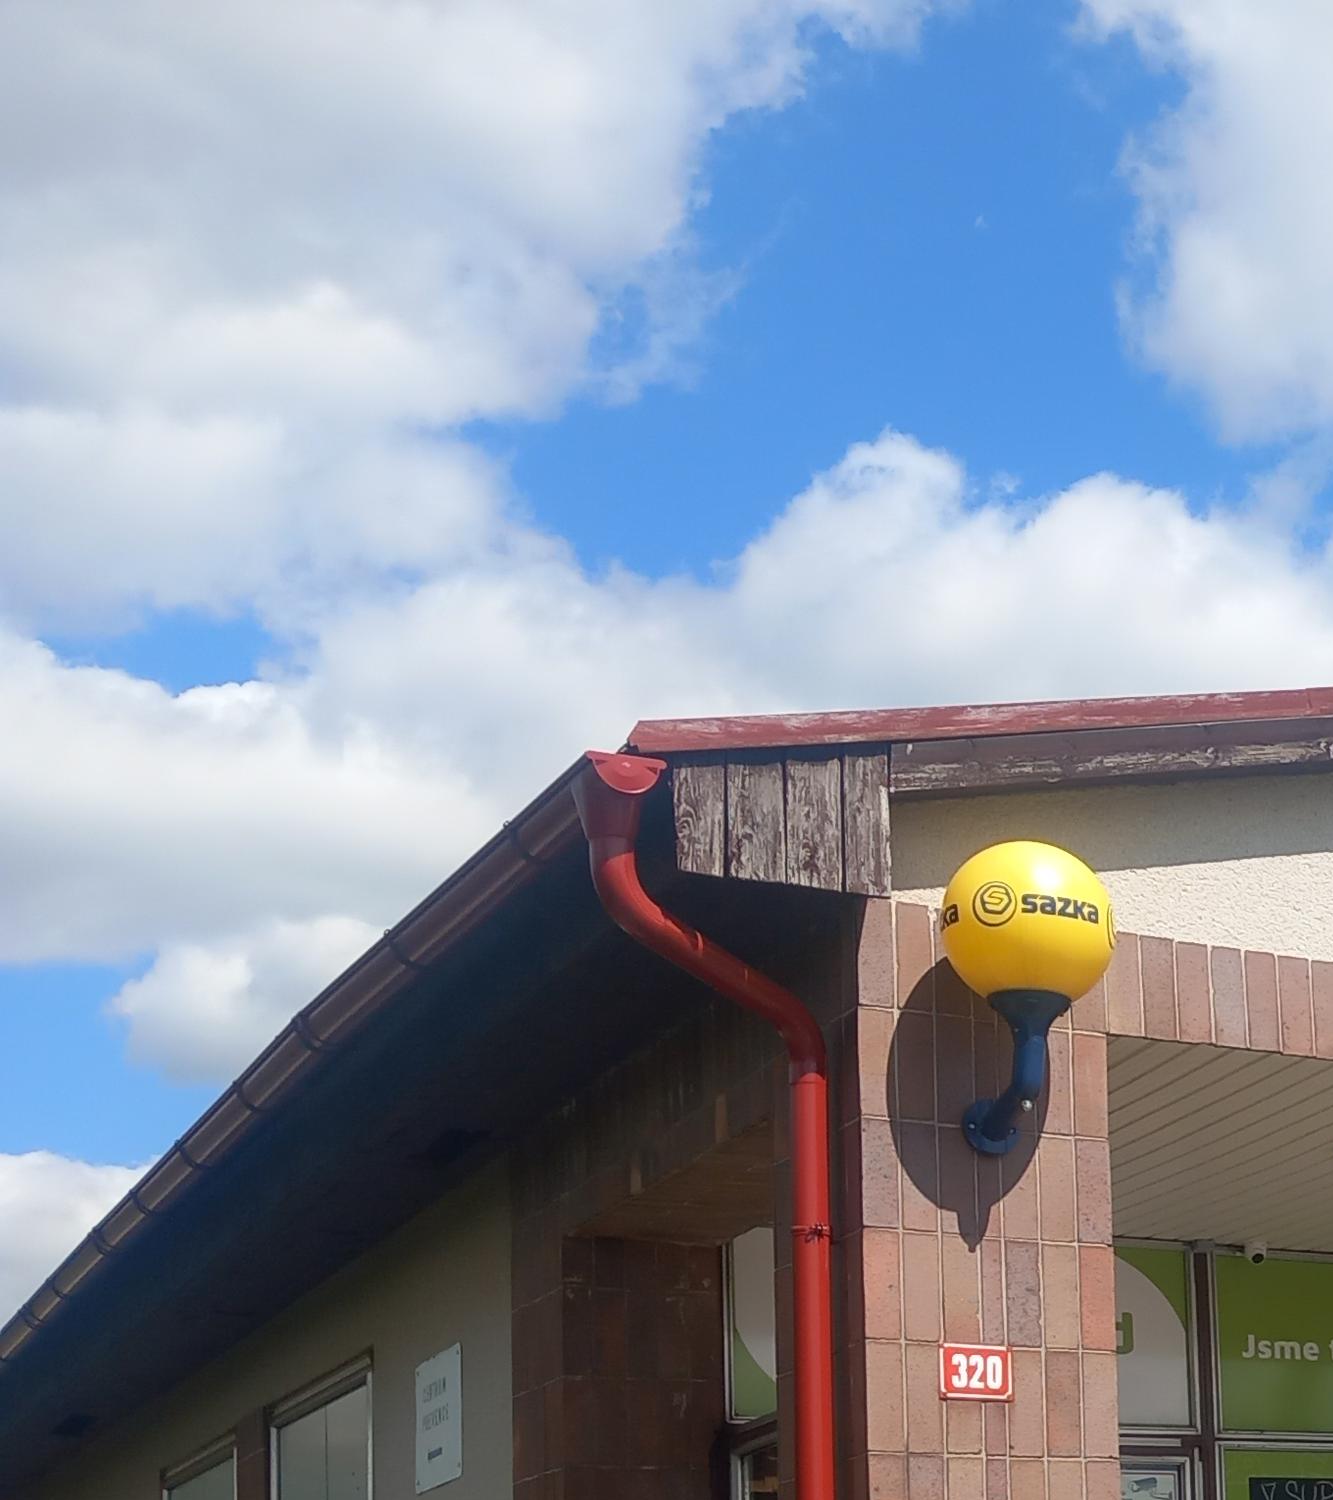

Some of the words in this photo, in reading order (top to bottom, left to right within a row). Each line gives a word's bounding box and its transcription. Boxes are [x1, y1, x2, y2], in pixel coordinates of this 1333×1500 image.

[1021, 892, 1099, 924] sazka
[1241, 1333, 1320, 1362] Jsme
[951, 1352, 1004, 1390] 320
